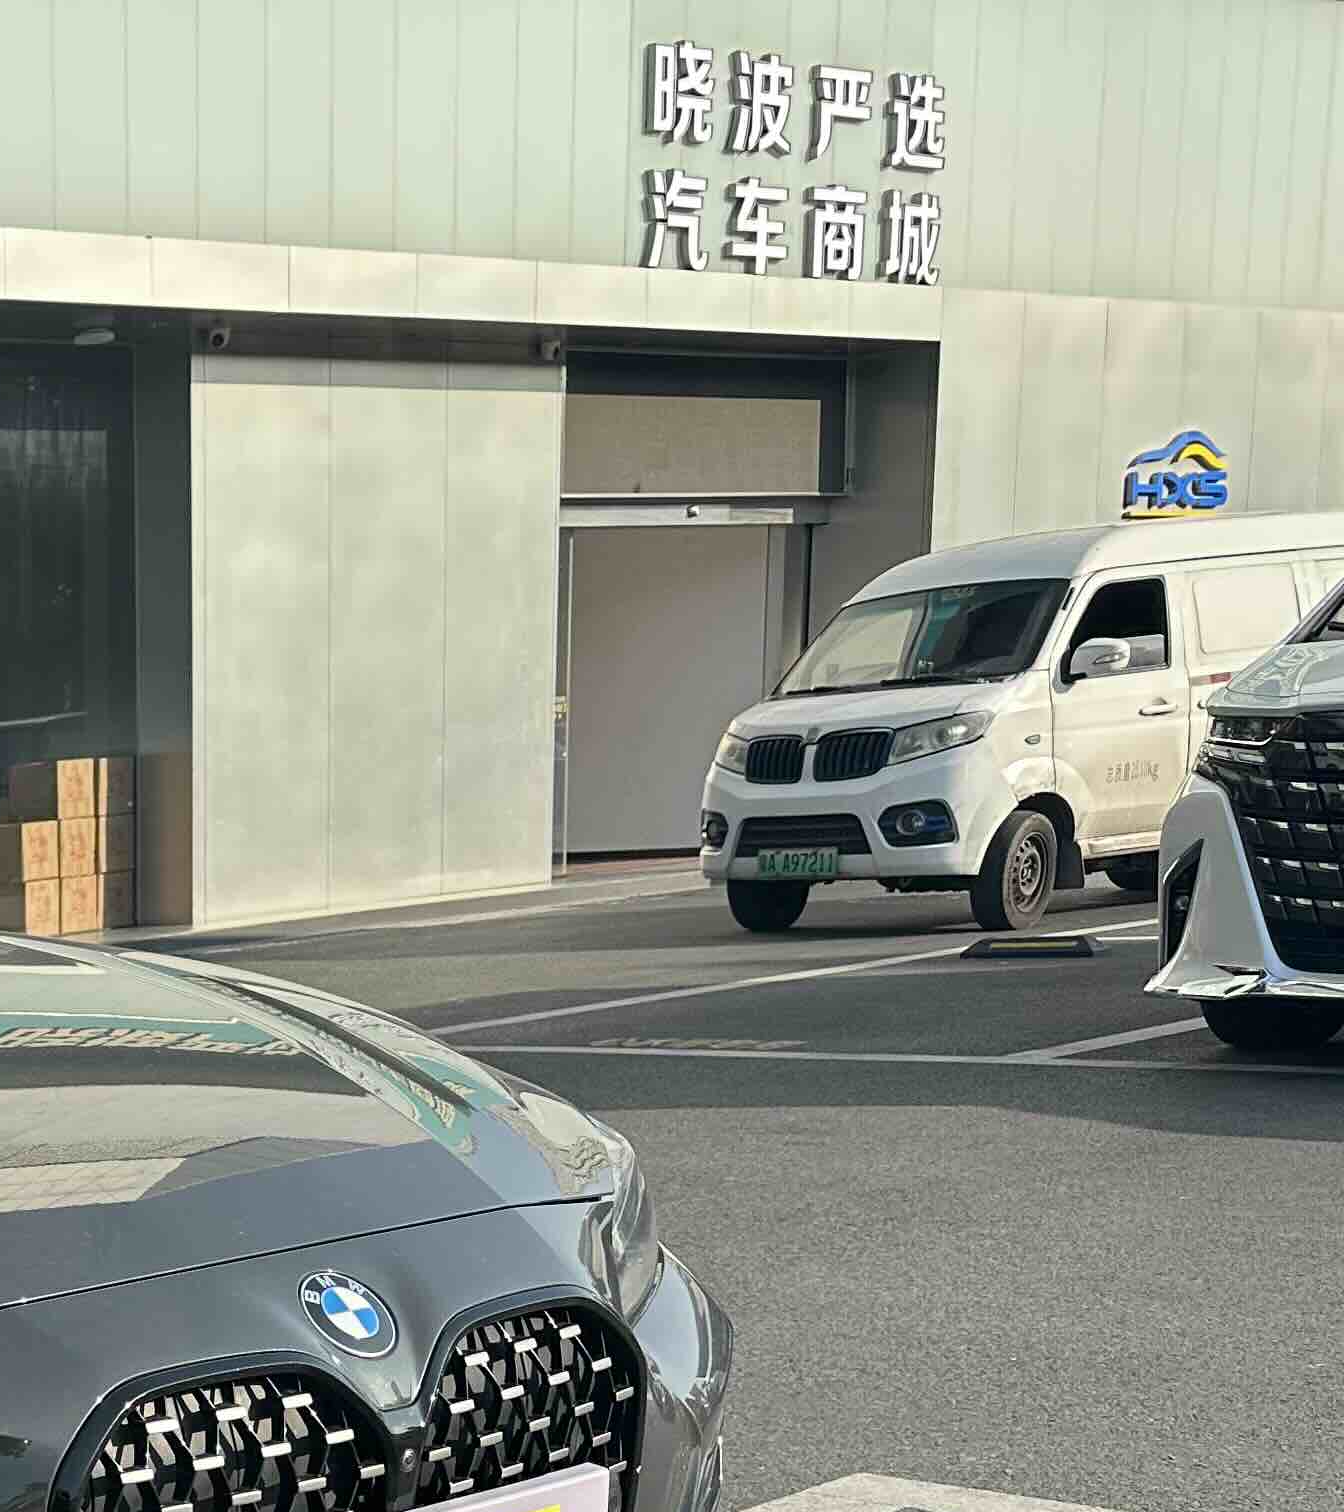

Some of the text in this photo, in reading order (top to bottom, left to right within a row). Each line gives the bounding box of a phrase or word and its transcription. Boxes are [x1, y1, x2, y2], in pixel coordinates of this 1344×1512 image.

[644, 39, 945, 170] 晓波严选
[640, 167, 941, 286] 汽车商城
[1123, 471, 1228, 509] HXS
[304, 1275, 368, 1305] BMW
